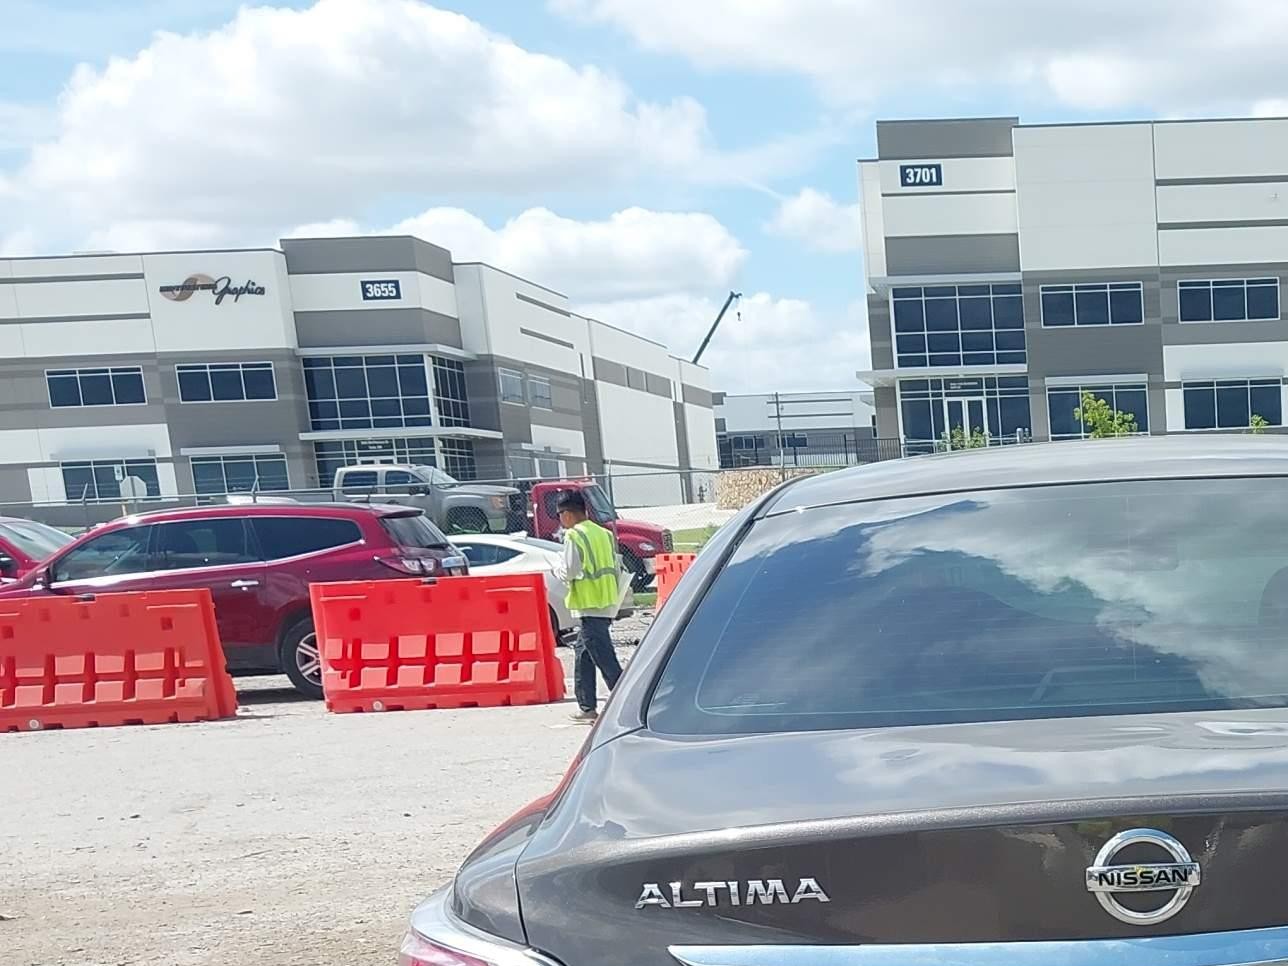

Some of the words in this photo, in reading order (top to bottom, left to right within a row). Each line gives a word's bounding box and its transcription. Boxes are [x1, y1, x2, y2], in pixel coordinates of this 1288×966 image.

[906, 167, 937, 183] 3701
[212, 276, 265, 305] Graphics
[365, 283, 397, 297] 3655
[1098, 868, 1189, 886] NISSAN
[635, 878, 831, 909] ALTIMA
